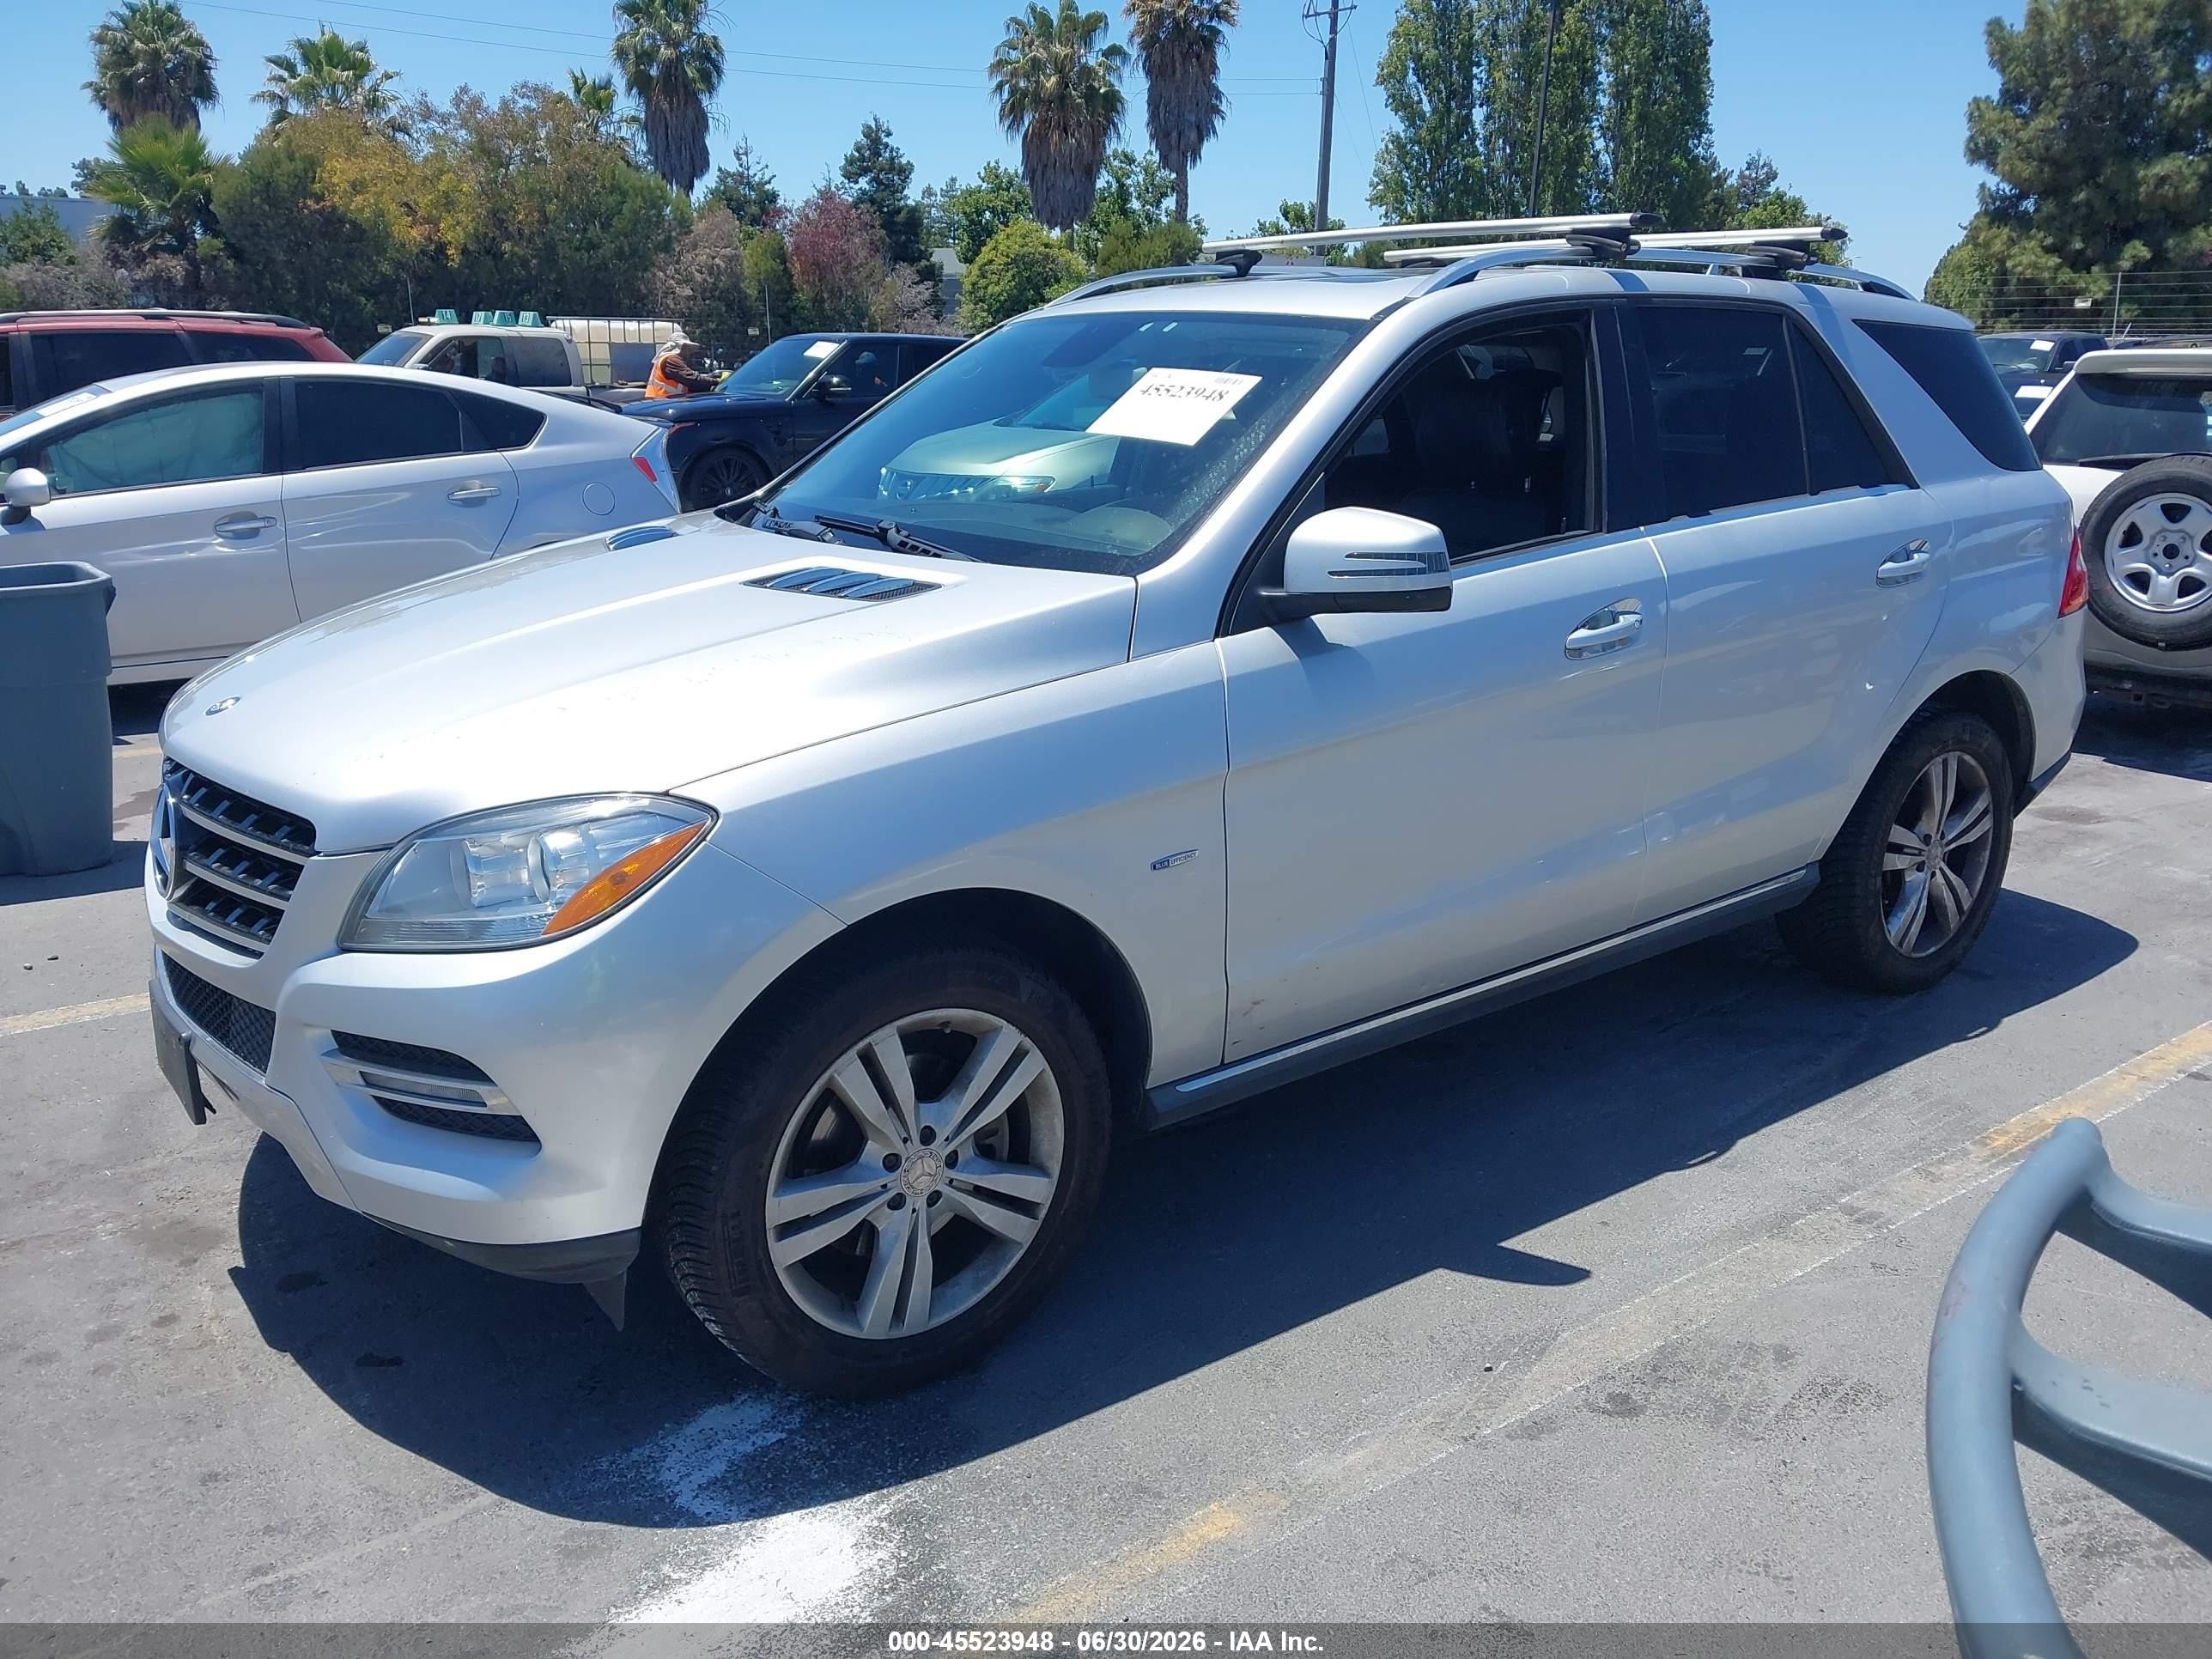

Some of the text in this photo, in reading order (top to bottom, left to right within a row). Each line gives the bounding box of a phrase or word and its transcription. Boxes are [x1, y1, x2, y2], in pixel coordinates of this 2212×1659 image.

[442, 310, 451, 320] 14
[1140, 383, 1230, 402] 45523948
[1170, 852, 1197, 865] EFFICIENCY
